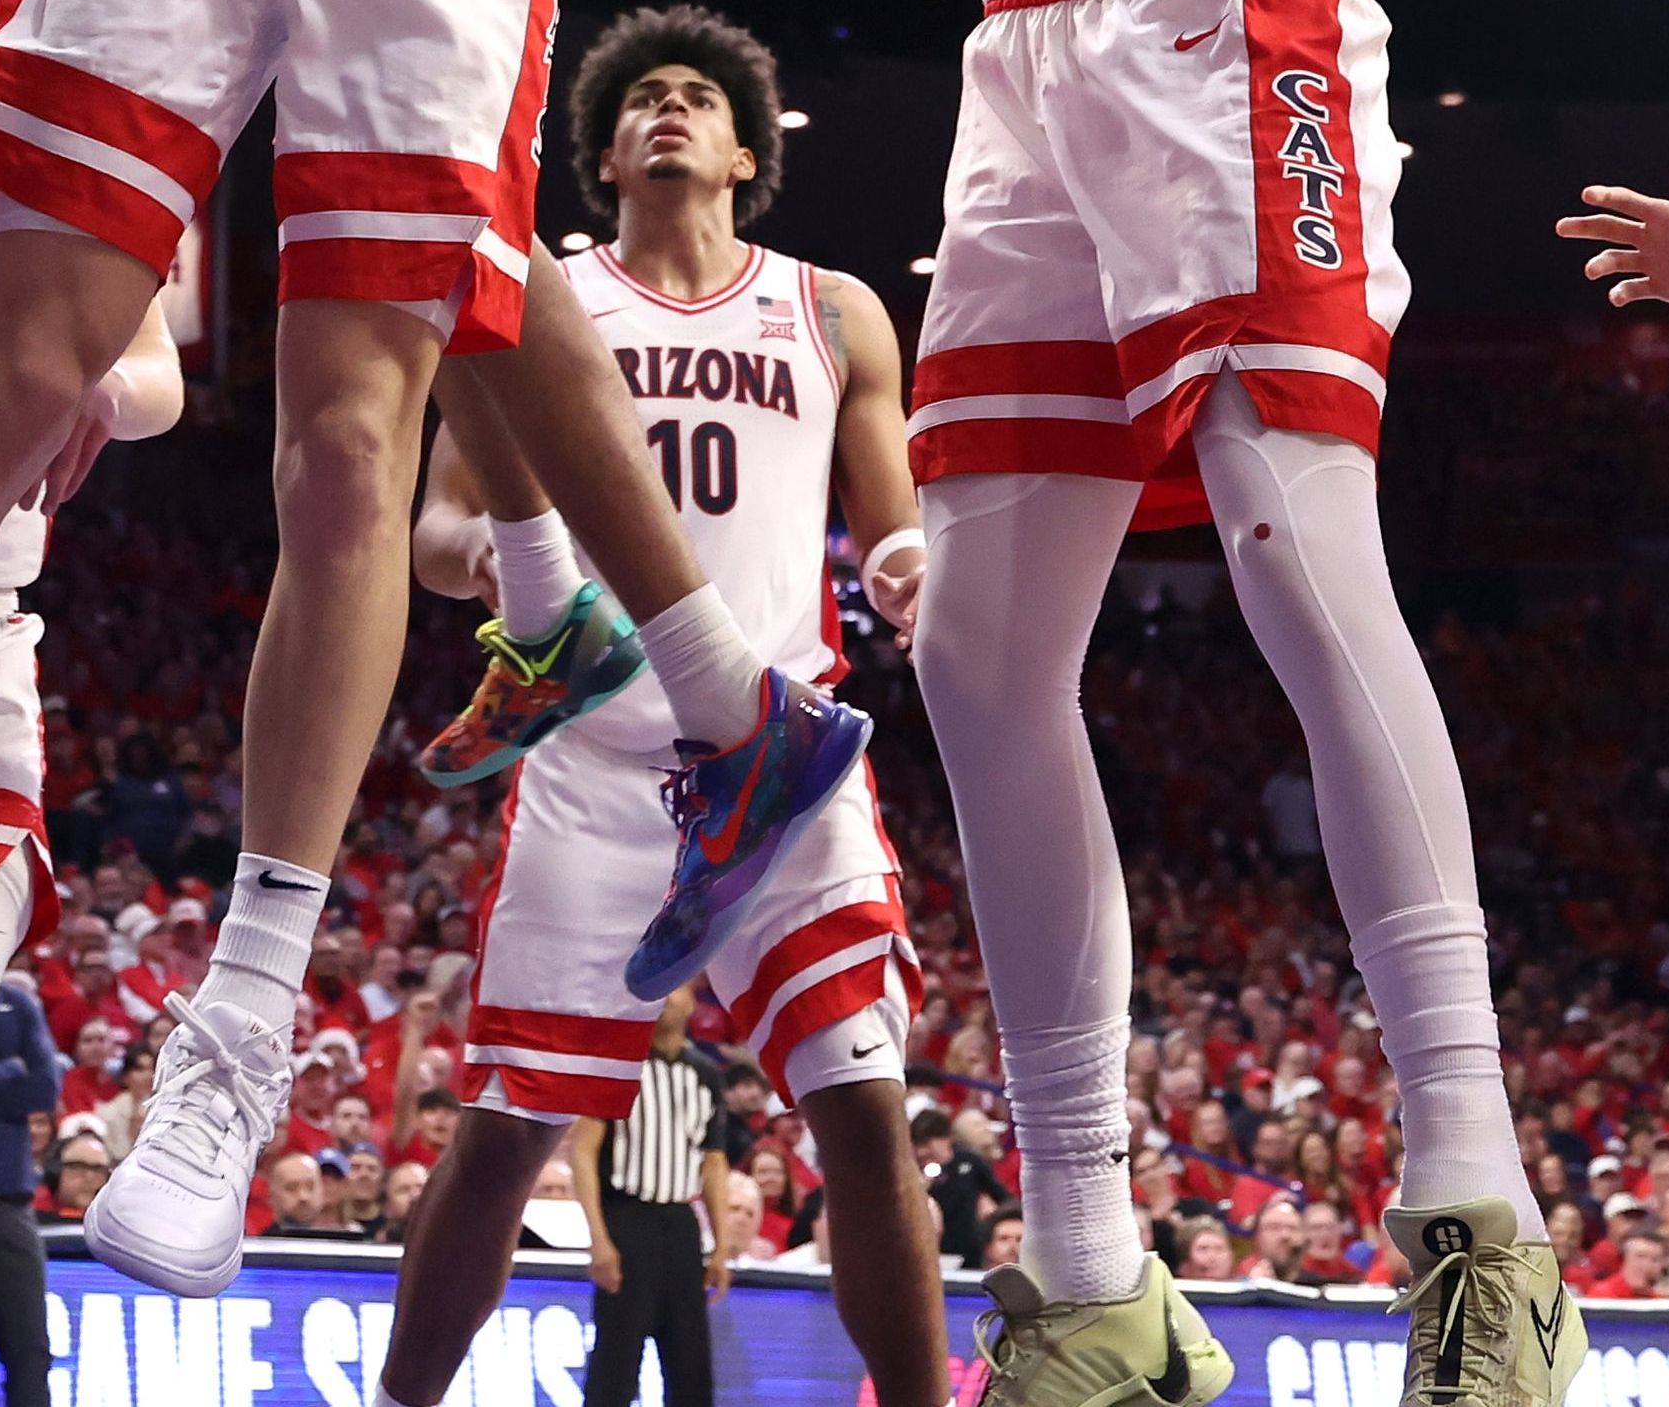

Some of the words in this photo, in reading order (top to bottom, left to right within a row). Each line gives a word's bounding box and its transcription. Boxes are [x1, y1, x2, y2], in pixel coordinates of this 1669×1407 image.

[1272, 69, 1345, 270] CATS
[612, 346, 800, 421] RIZONA
[647, 419, 738, 516] 10
